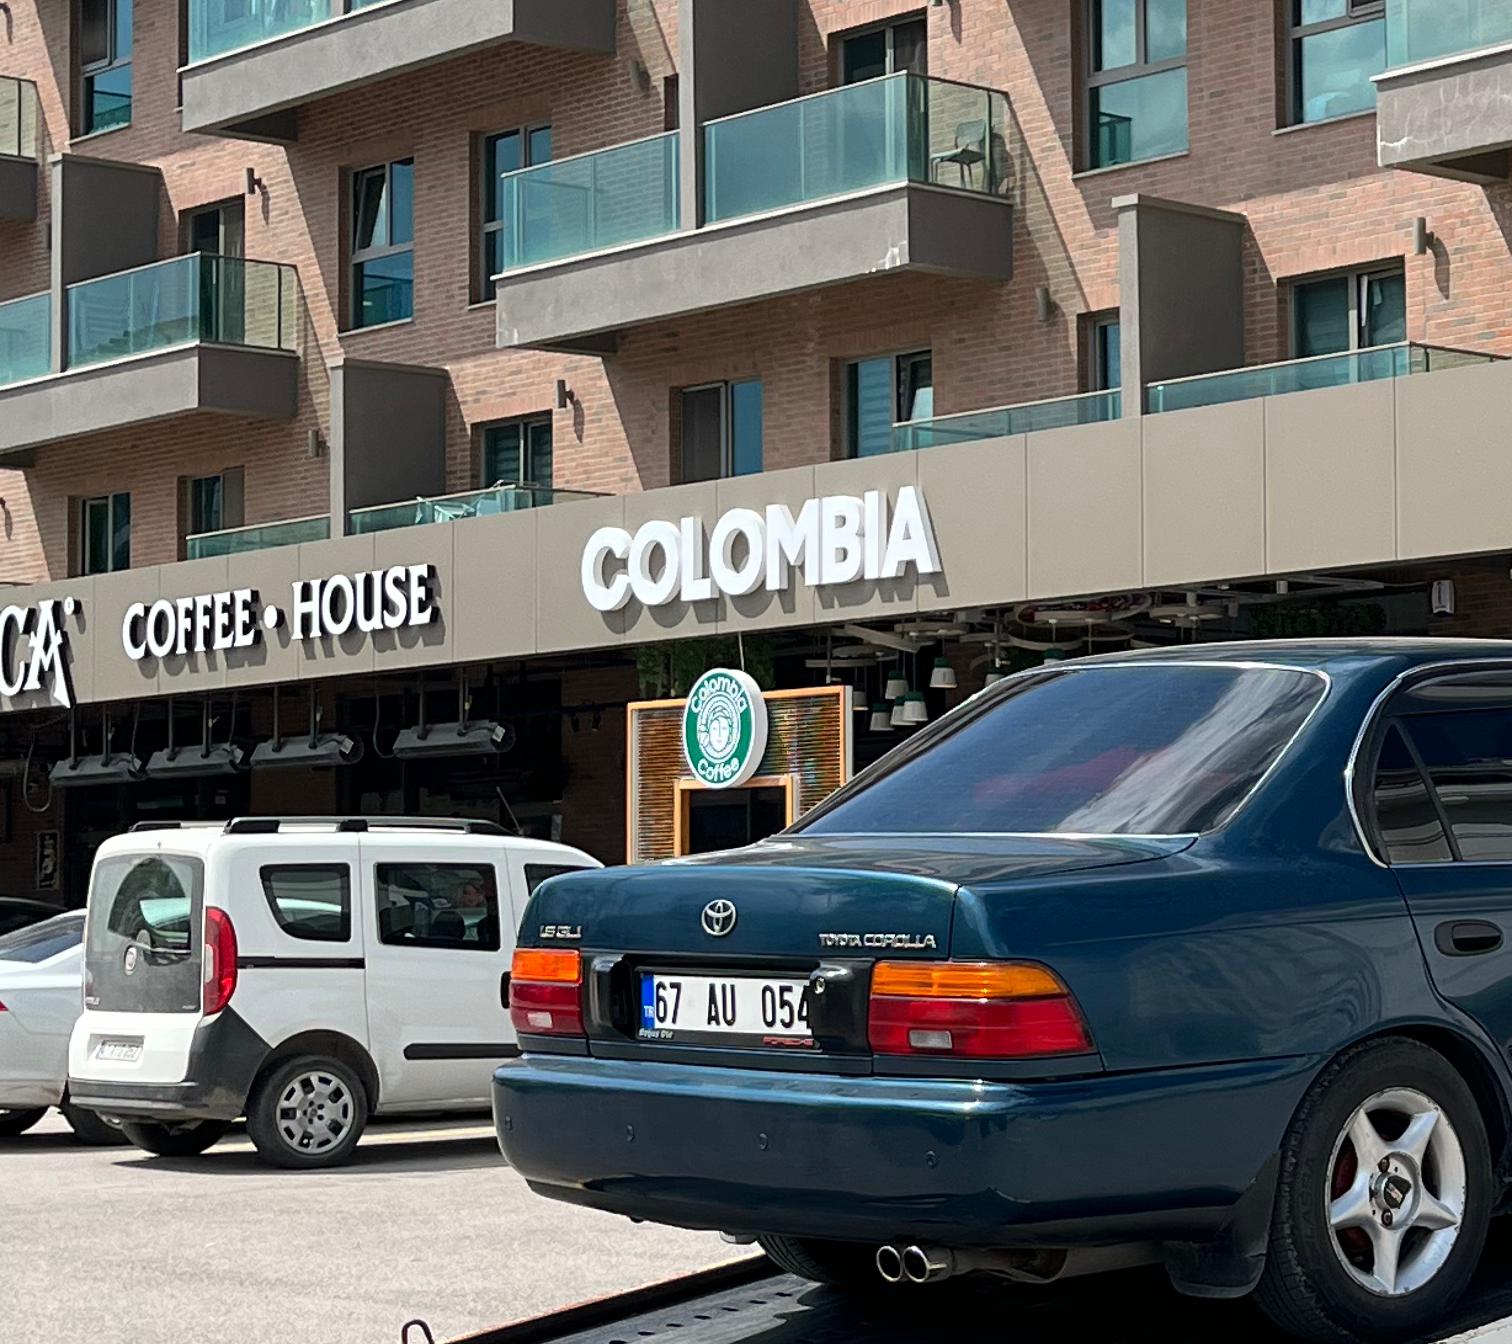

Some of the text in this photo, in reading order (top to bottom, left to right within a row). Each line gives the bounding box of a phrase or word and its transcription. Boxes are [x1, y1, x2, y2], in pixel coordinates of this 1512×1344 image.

[581, 485, 942, 611] COLOMBIA
[122, 563, 434, 661] COFFEE HOUSE
[698, 757, 740, 782] Coffee
[818, 933, 937, 949] TOYOTA COROLLA
[655, 980, 812, 1029] 67 AU 054
